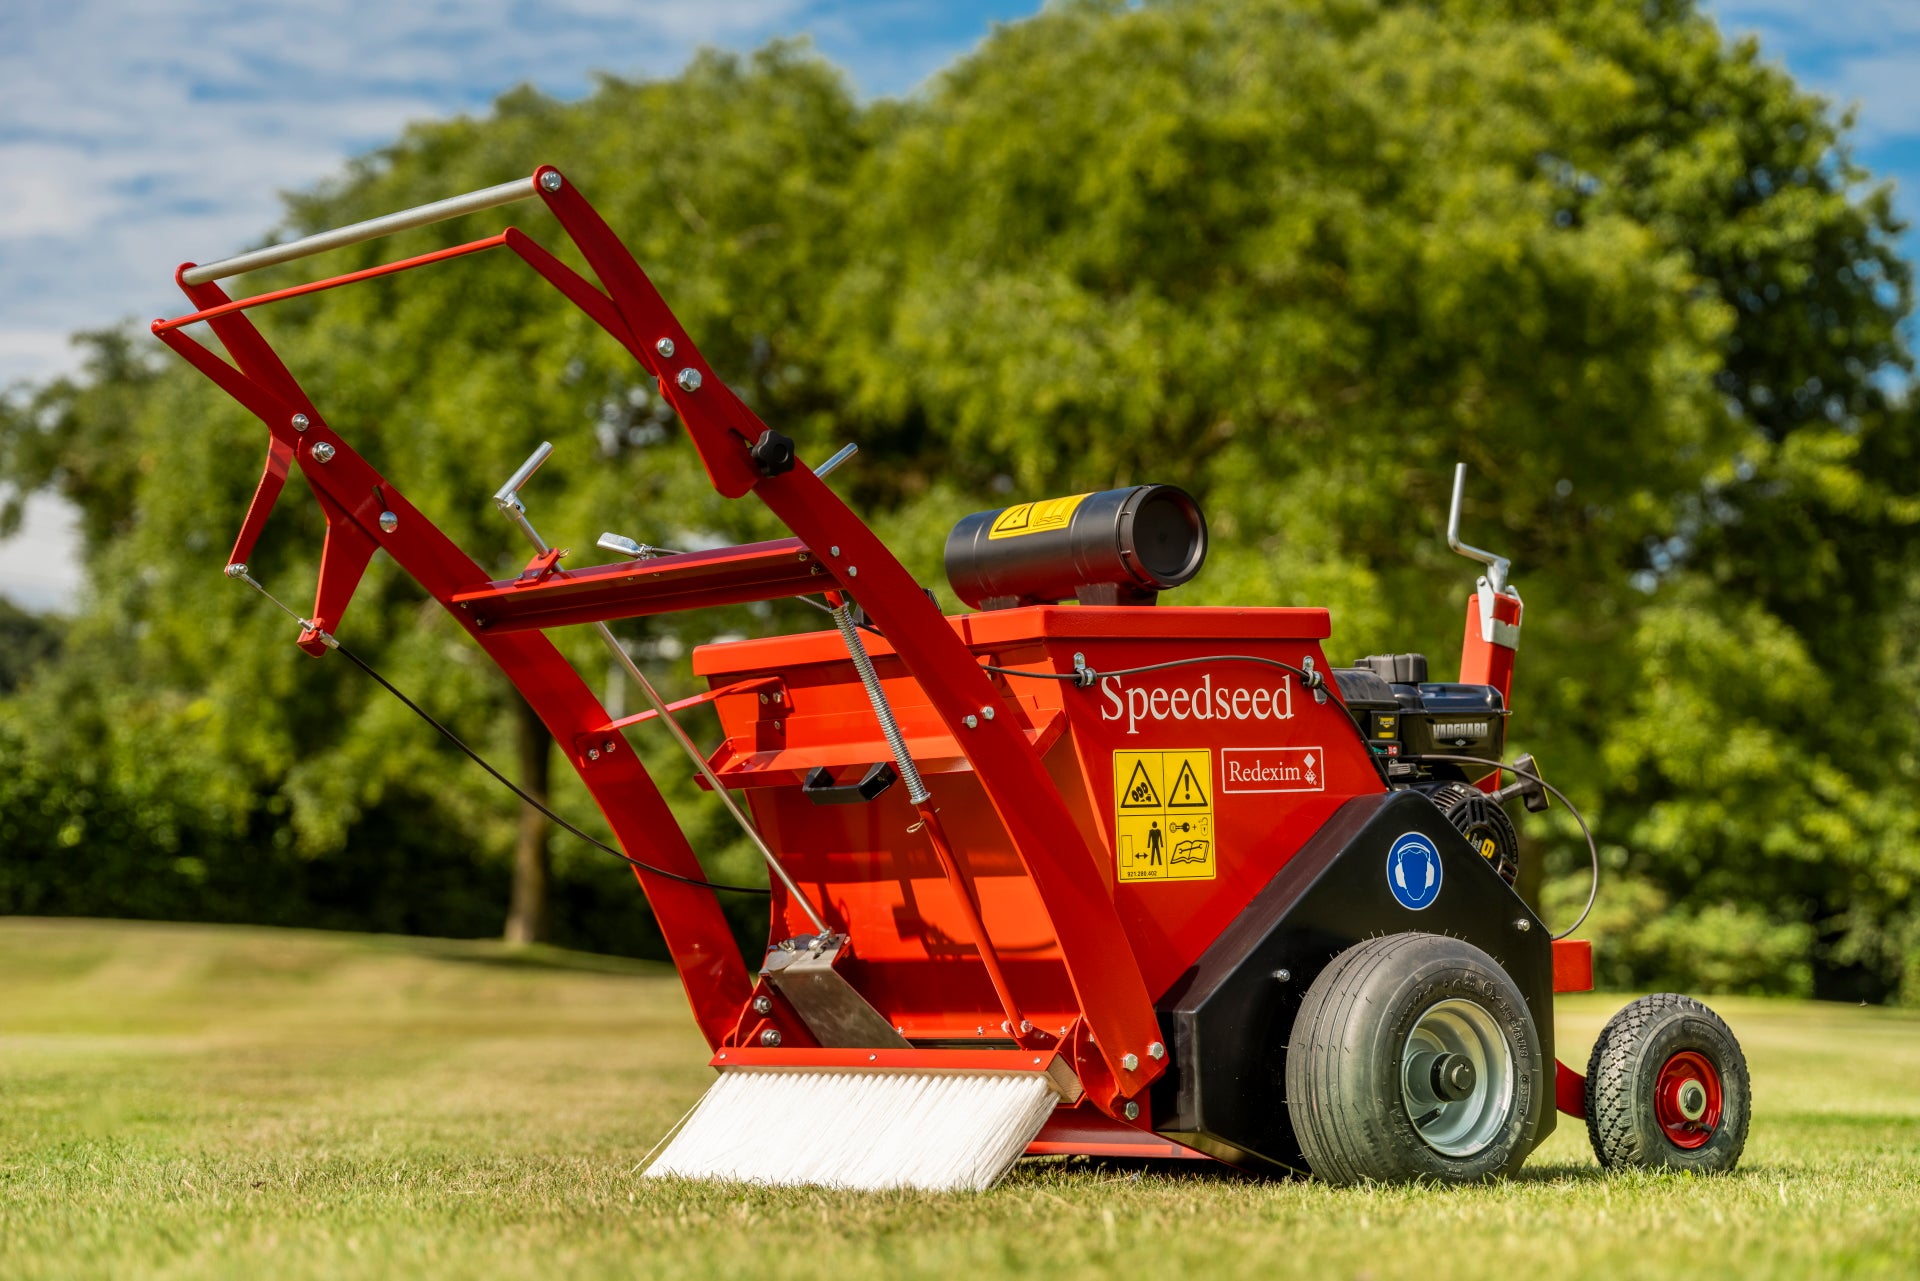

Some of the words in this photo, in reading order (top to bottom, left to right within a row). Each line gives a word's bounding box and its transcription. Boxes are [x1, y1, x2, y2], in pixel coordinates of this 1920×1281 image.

[1101, 674, 1294, 734] Speedseed
[1432, 723, 1488, 739] VANGUARD
[1229, 760, 1301, 782] Redexim
